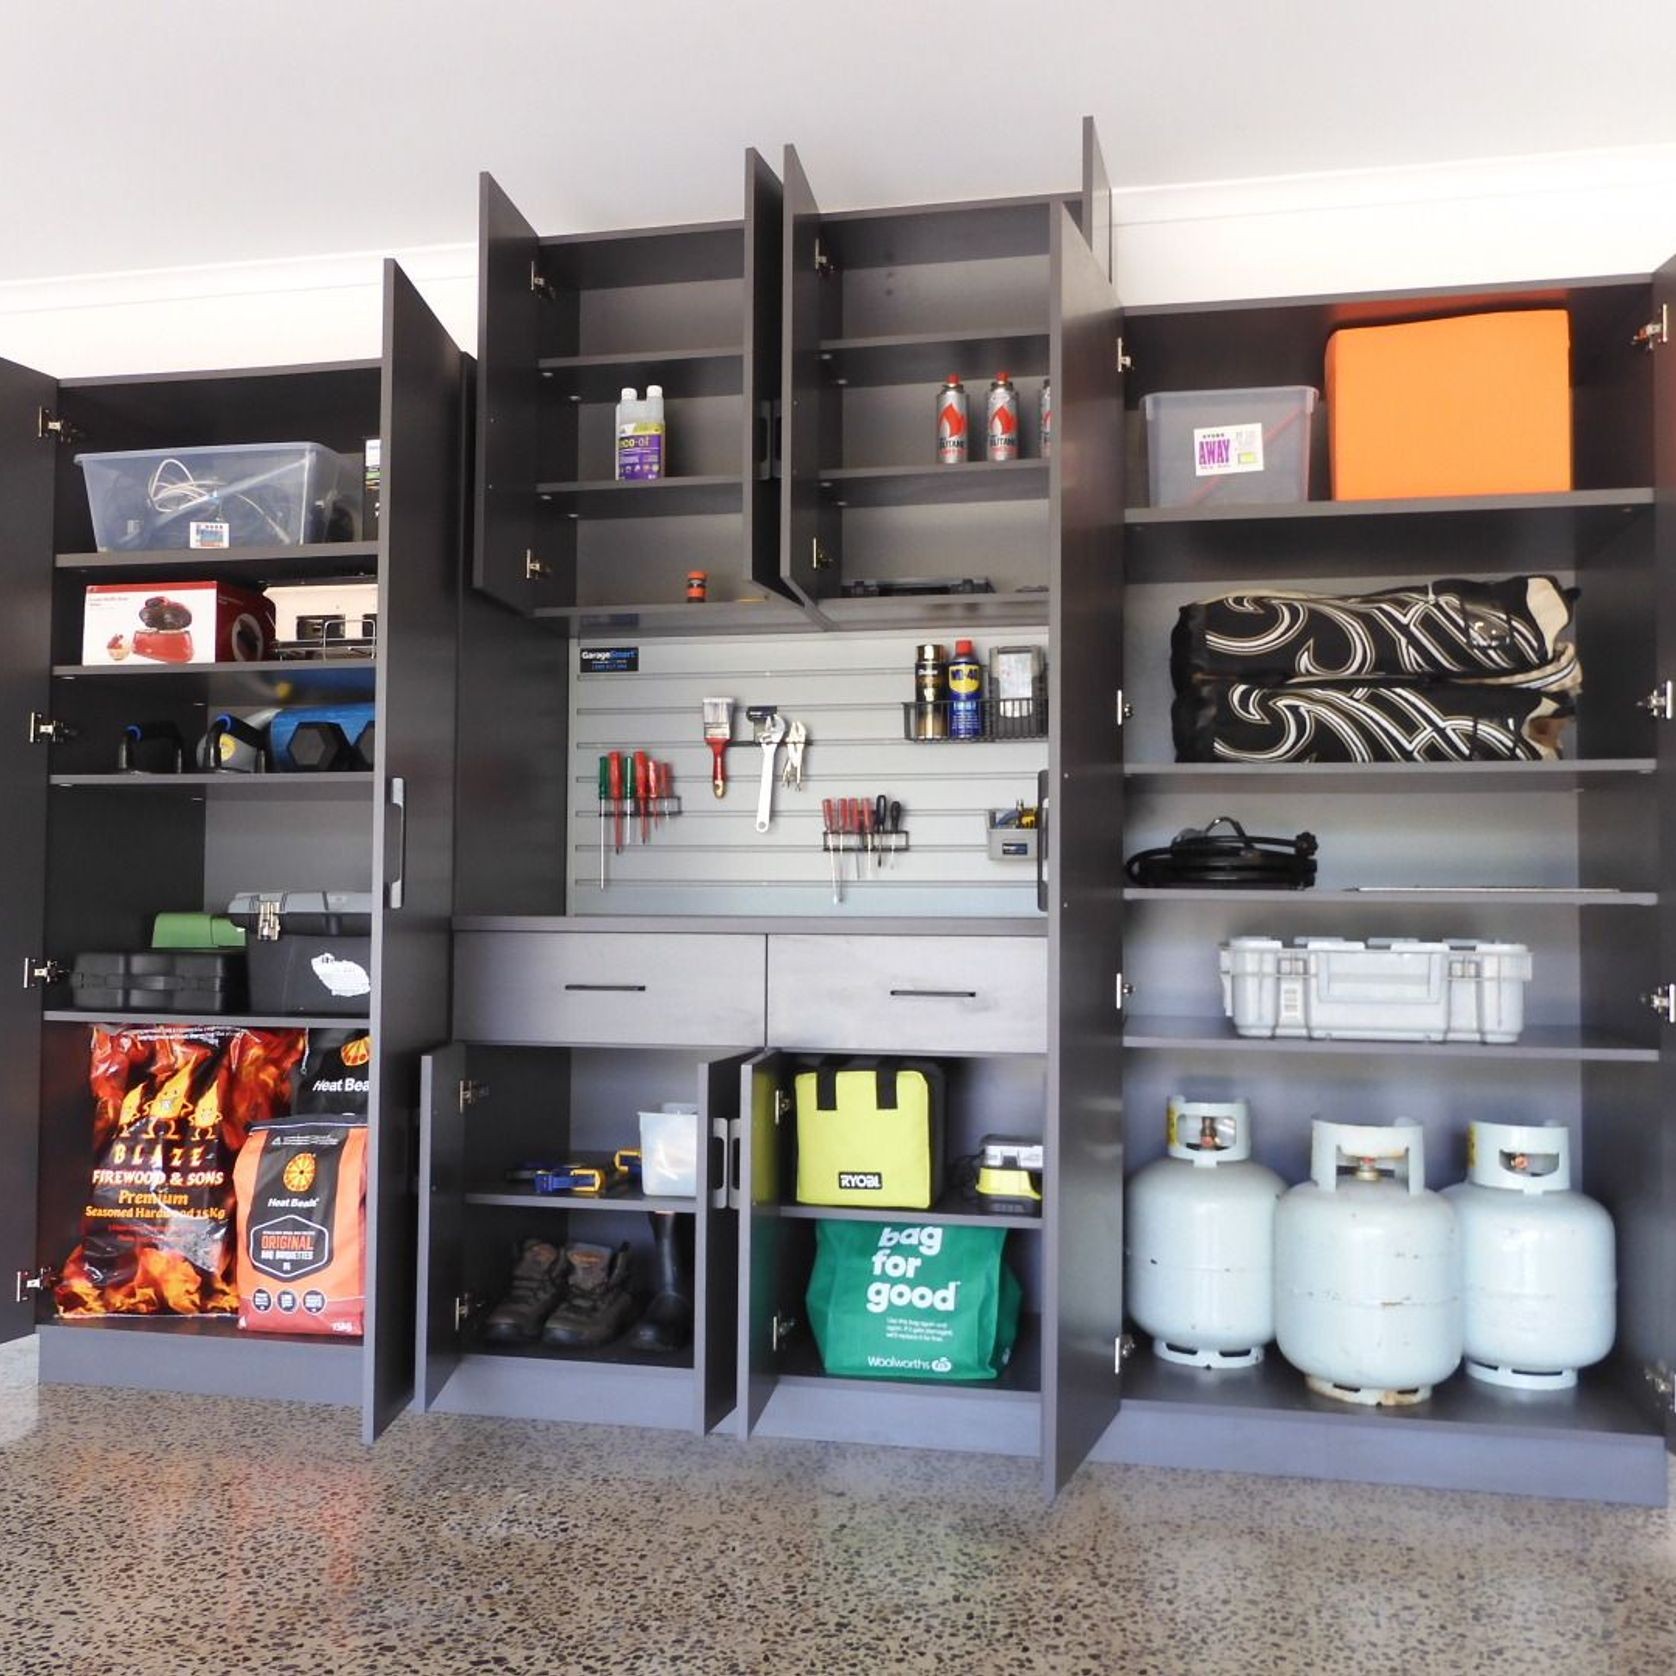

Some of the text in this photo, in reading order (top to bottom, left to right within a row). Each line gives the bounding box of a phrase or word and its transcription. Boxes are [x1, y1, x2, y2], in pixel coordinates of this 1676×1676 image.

[1199, 439, 1230, 465] AWAY
[312, 1080, 343, 1092] Heat
[113, 1143, 205, 1167] BLAZE
[92, 1169, 224, 1186] FIREWOOD & SONS
[840, 1174, 881, 1188] RYOBI
[118, 1189, 189, 1206] Premium
[267, 1198, 290, 1208] Heat
[85, 1206, 133, 1218] Seasoned
[135, 1207, 195, 1219] Hardwod
[261, 1235, 314, 1250] ORIGINAL
[878, 1226, 943, 1256] bag
[871, 1249, 922, 1278] for
[866, 1281, 956, 1313] good
[868, 1356, 930, 1370] Woolworths
